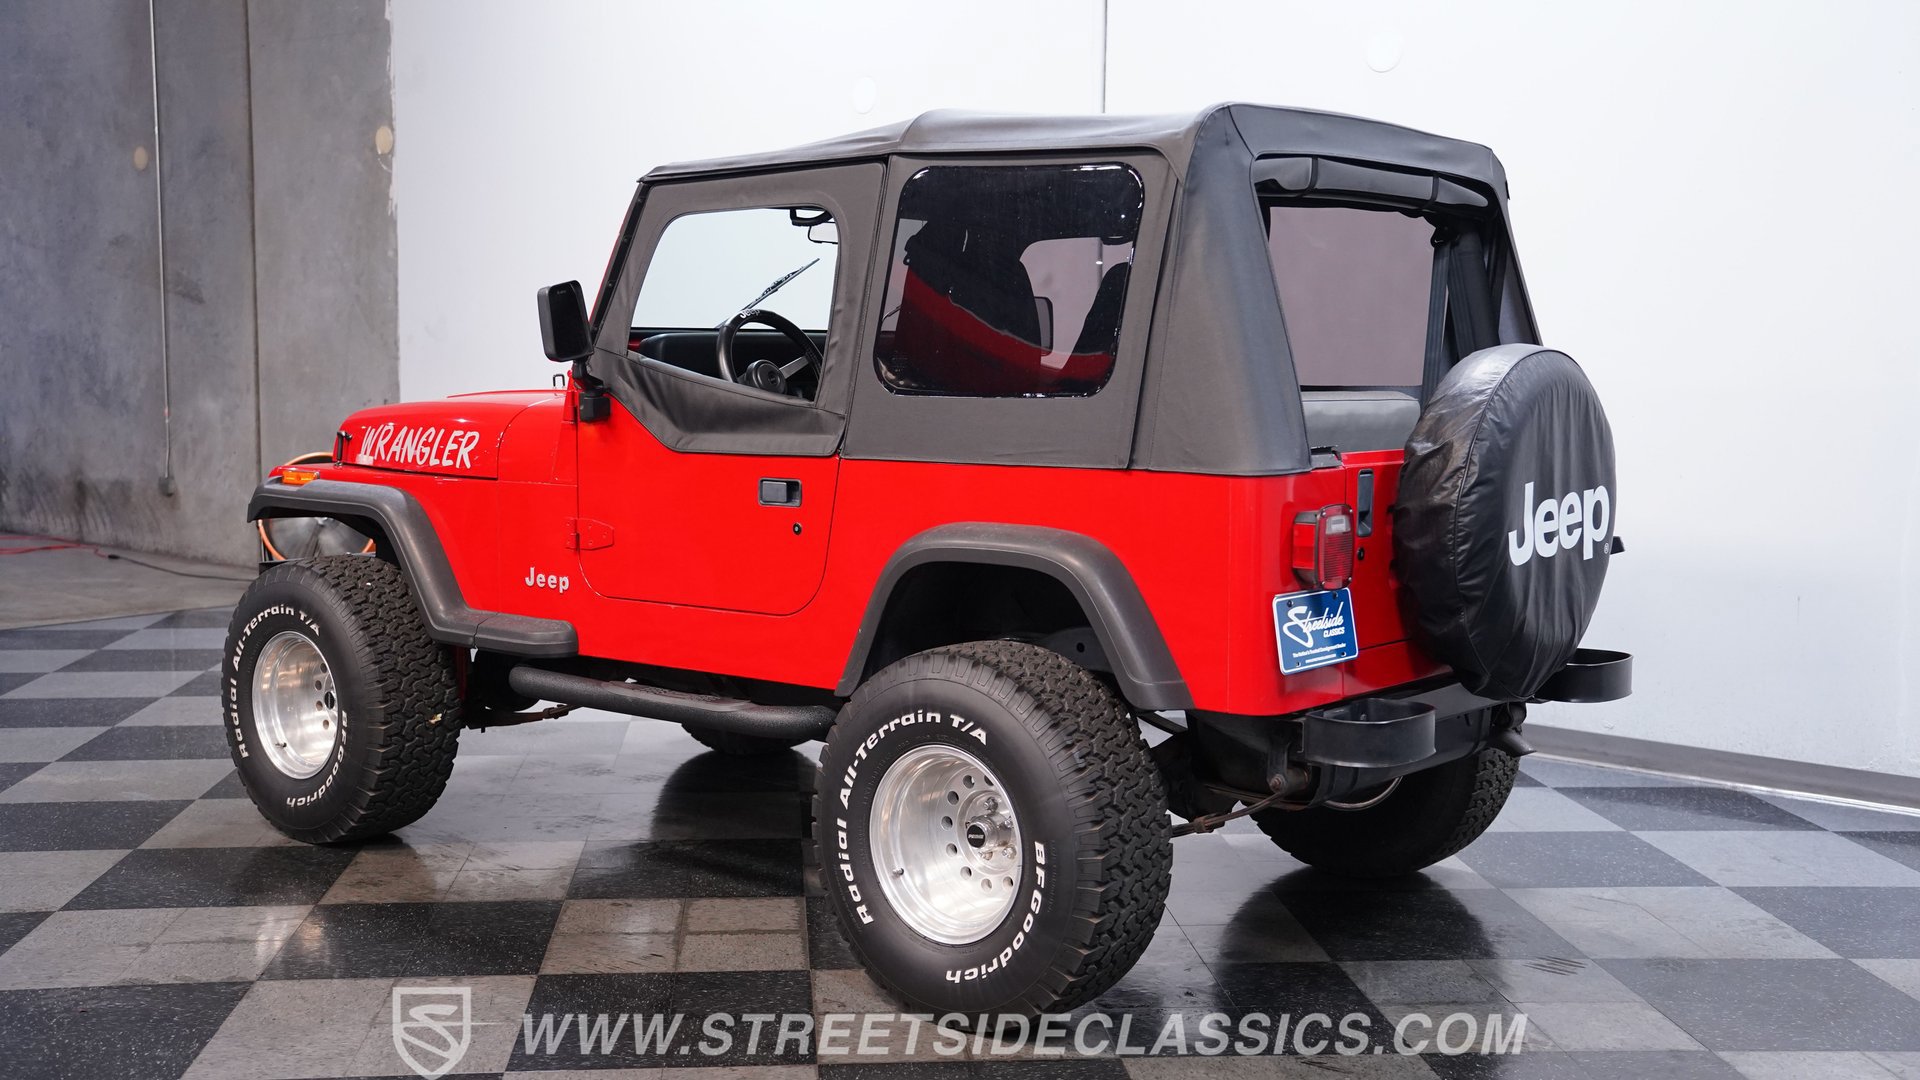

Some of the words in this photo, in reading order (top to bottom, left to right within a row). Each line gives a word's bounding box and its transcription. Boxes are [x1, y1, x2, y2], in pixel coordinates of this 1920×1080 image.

[739, 308, 761, 319] Jeep
[362, 424, 479, 468] WRANGLER
[1509, 482, 1609, 566] Jeep
[524, 567, 569, 593] Jeep
[232, 604, 295, 672] All-Terrain
[297, 610, 321, 637] T/A
[230, 678, 250, 758] Radial
[949, 714, 987, 746] T/A
[838, 709, 942, 810] All-Terrain
[837, 818, 874, 924] Radial
